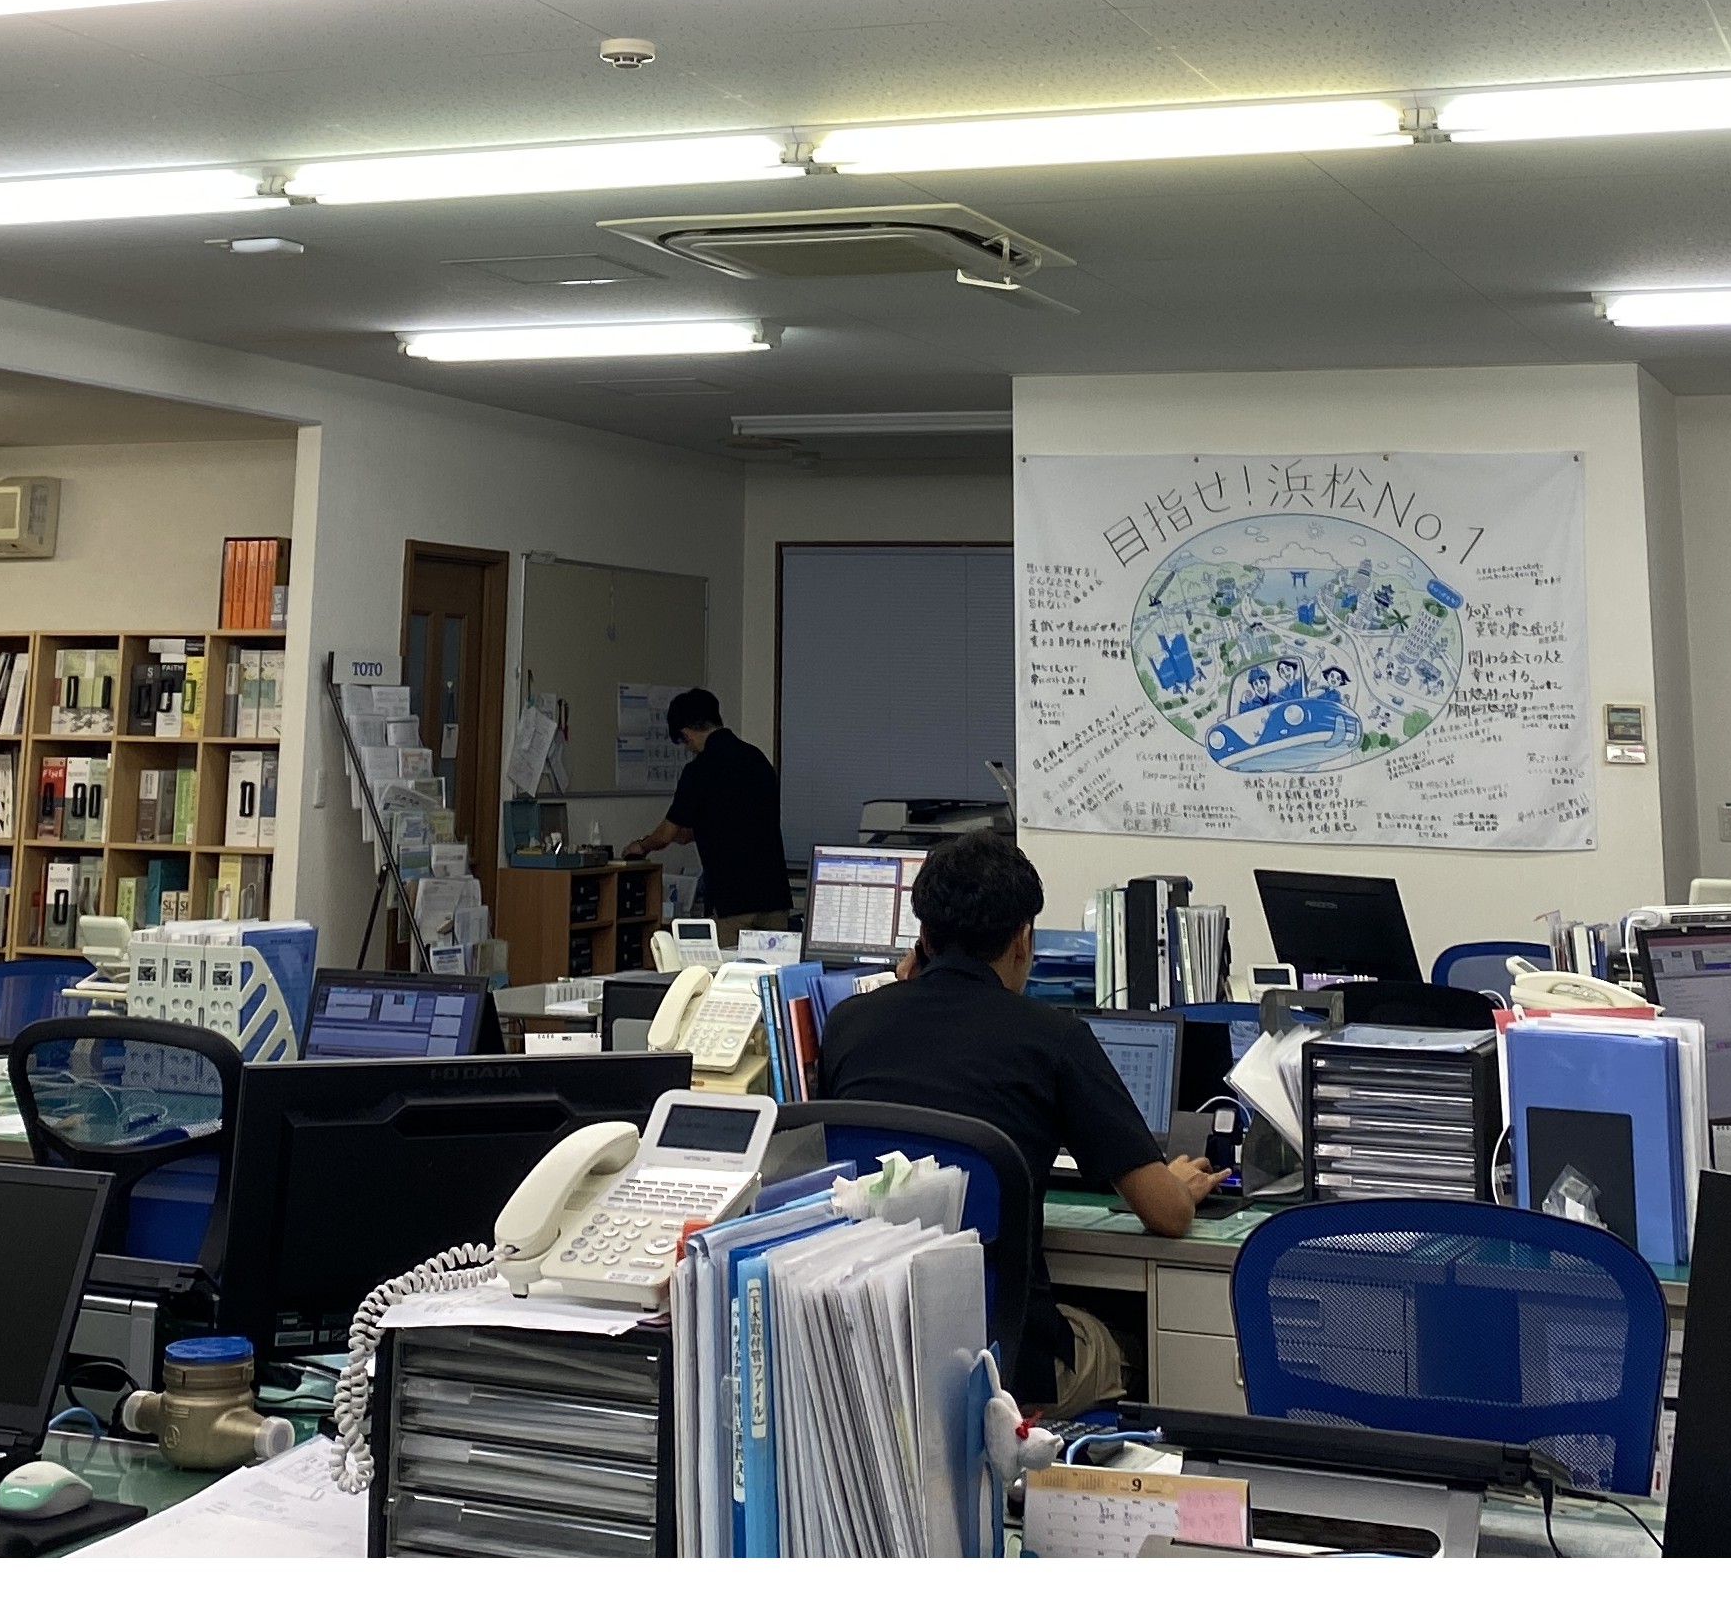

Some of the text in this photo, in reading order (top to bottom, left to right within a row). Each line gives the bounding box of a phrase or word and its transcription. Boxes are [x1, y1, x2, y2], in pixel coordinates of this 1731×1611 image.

[161, 664, 184, 672] FAITH
[351, 661, 383, 677] TOTO
[1131, 1477, 1143, 1492] 9
